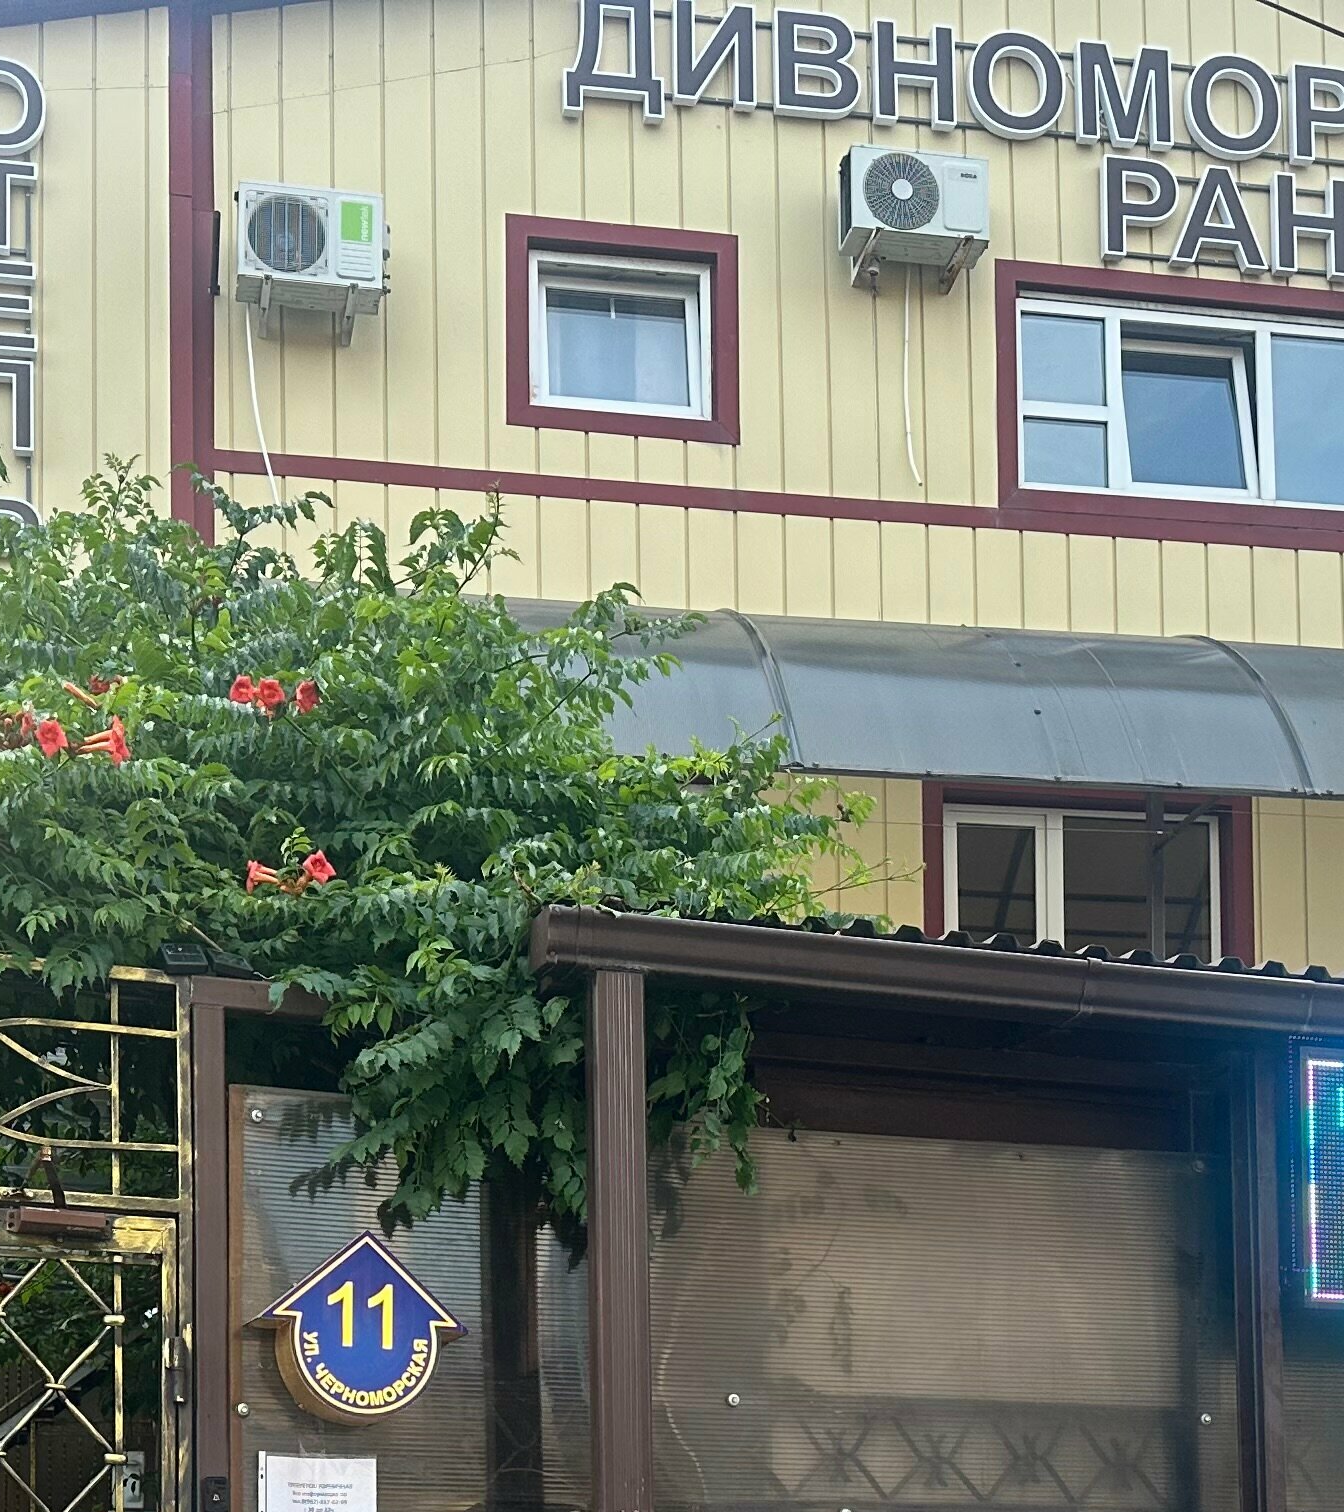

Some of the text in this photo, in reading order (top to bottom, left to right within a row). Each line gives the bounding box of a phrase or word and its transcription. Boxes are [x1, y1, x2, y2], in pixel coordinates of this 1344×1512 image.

[327, 1280, 394, 1350] 11
[302, 1331, 429, 1407] УЛ. ЧЕРНОМОРСКАЯ
